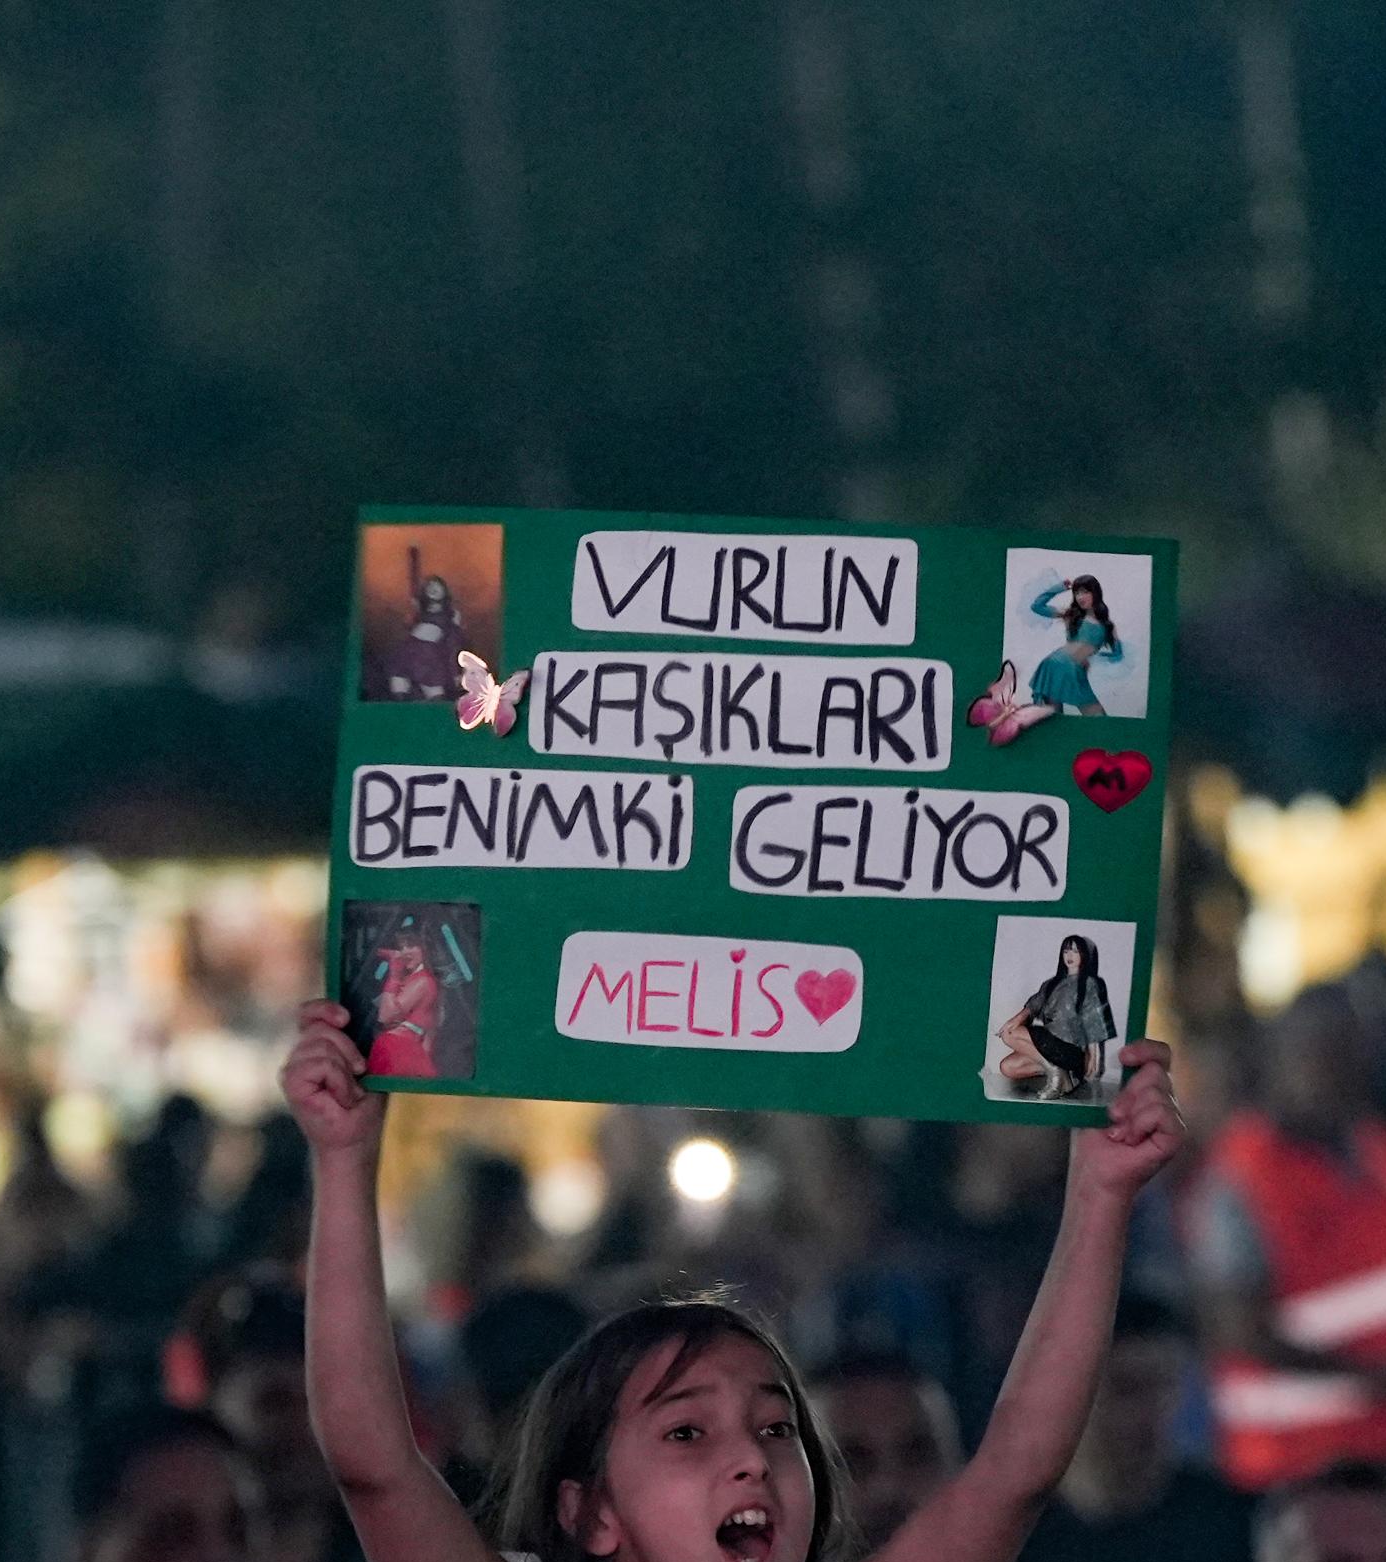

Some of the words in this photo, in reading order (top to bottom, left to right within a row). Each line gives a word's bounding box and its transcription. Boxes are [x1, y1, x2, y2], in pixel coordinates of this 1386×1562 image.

[584, 539, 901, 634] VURUN
[541, 656, 939, 764] KAŞIKLARI
[355, 769, 685, 866] BENİMKİ
[734, 788, 1060, 893] GELİYOR
[566, 946, 789, 1038] MELİS
